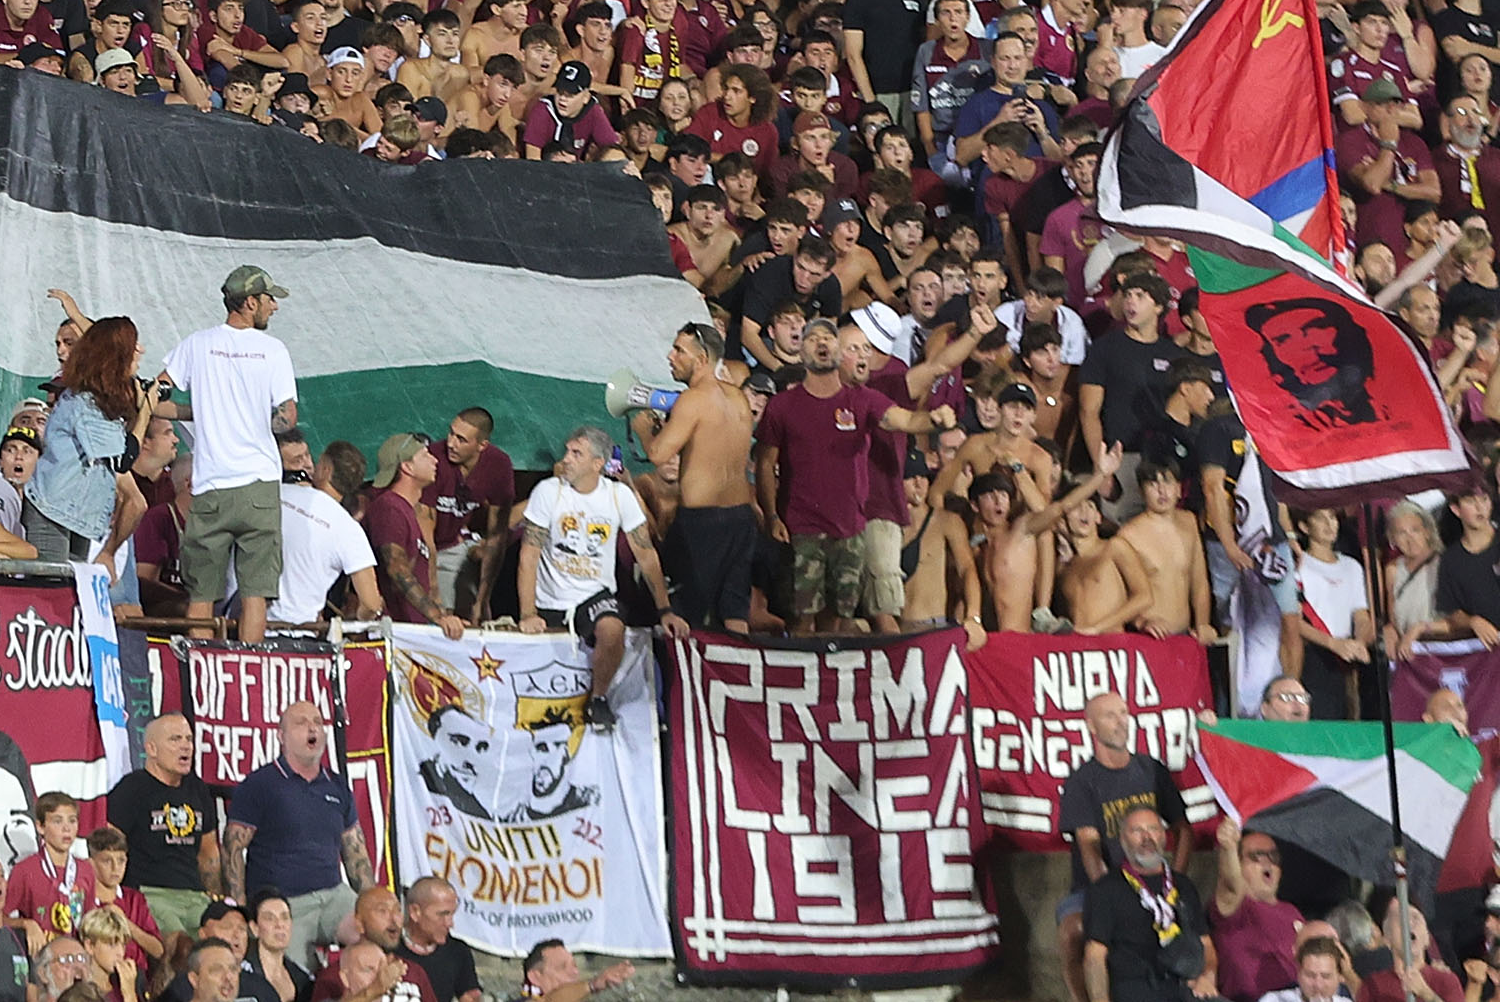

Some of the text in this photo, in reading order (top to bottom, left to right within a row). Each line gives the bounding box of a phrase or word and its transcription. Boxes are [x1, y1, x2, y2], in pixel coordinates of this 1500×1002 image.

[704, 643, 970, 742] PRIMA
[714, 734, 970, 835] LINEA
[747, 828, 987, 925] 1915
